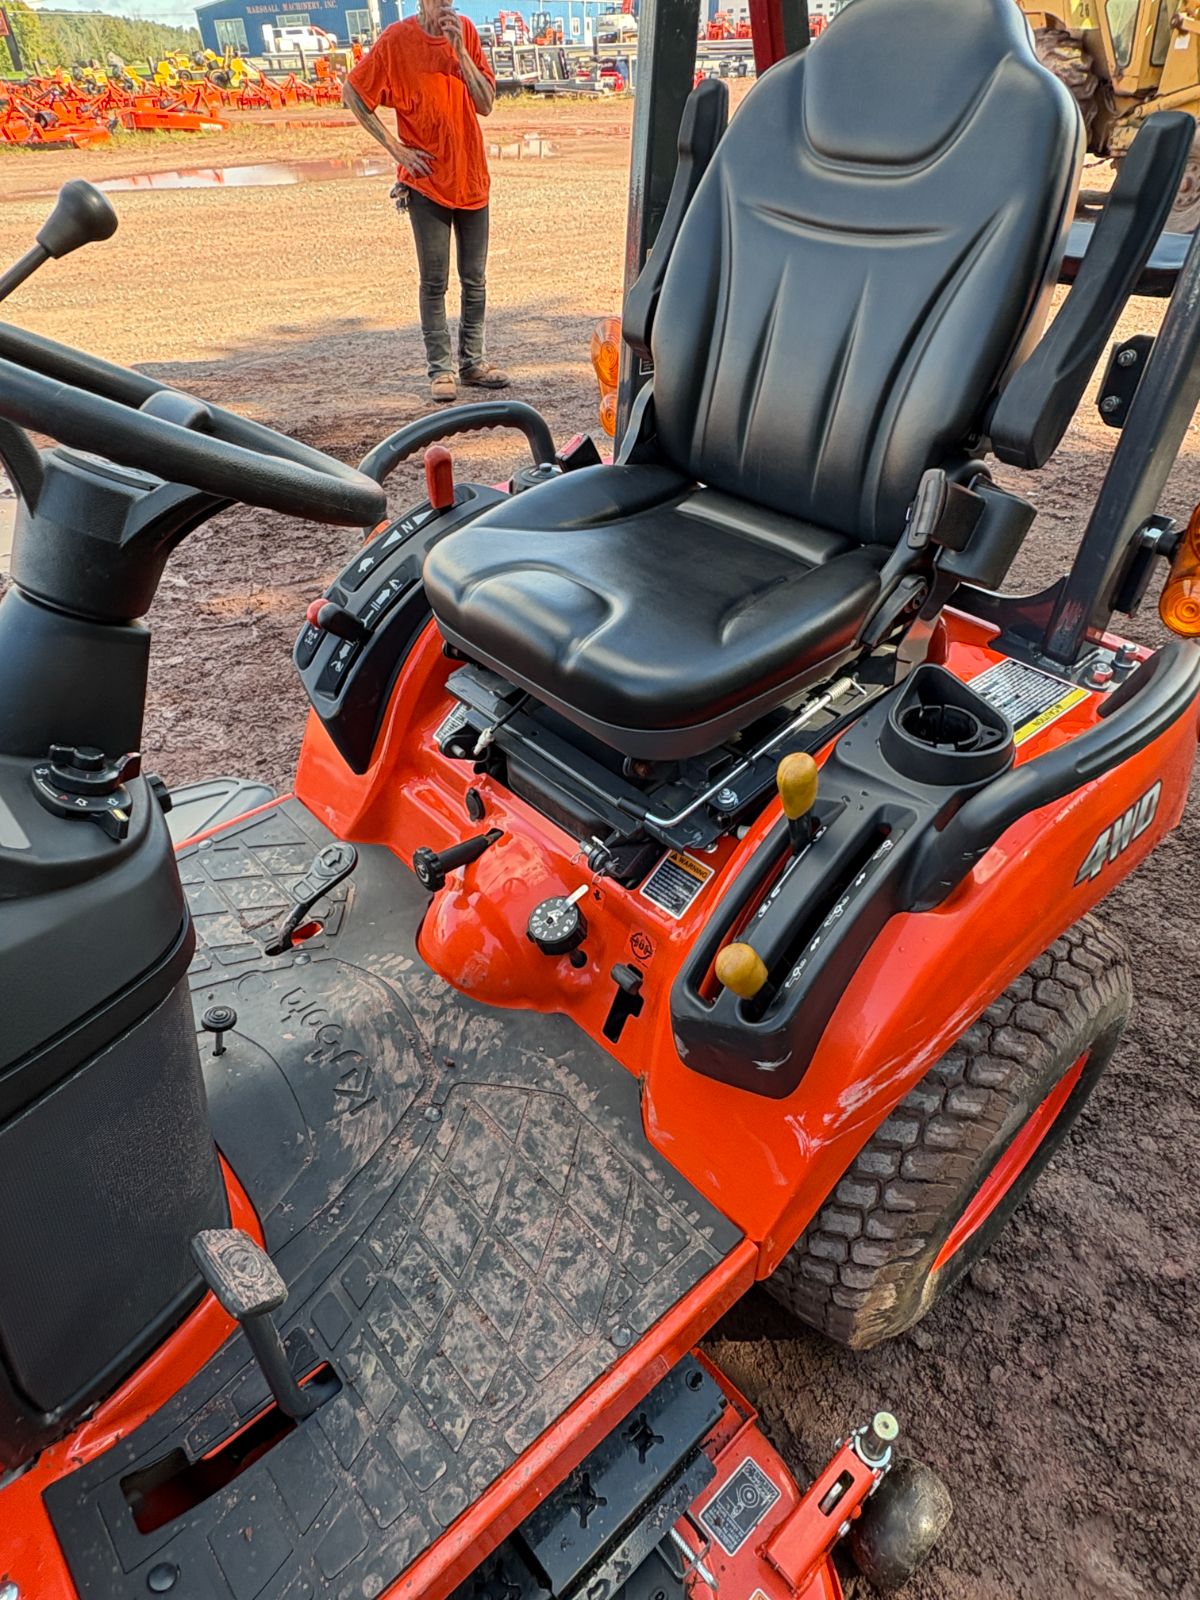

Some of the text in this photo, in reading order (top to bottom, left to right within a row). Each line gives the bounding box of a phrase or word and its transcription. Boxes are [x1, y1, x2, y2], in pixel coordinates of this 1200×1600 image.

[246, 4, 280, 14] MARSHALL
[401, 521, 414, 533] N
[1073, 779, 1163, 888] 4WD
[679, 856, 708, 879] WARNING
[279, 986, 379, 1117] Kubota
